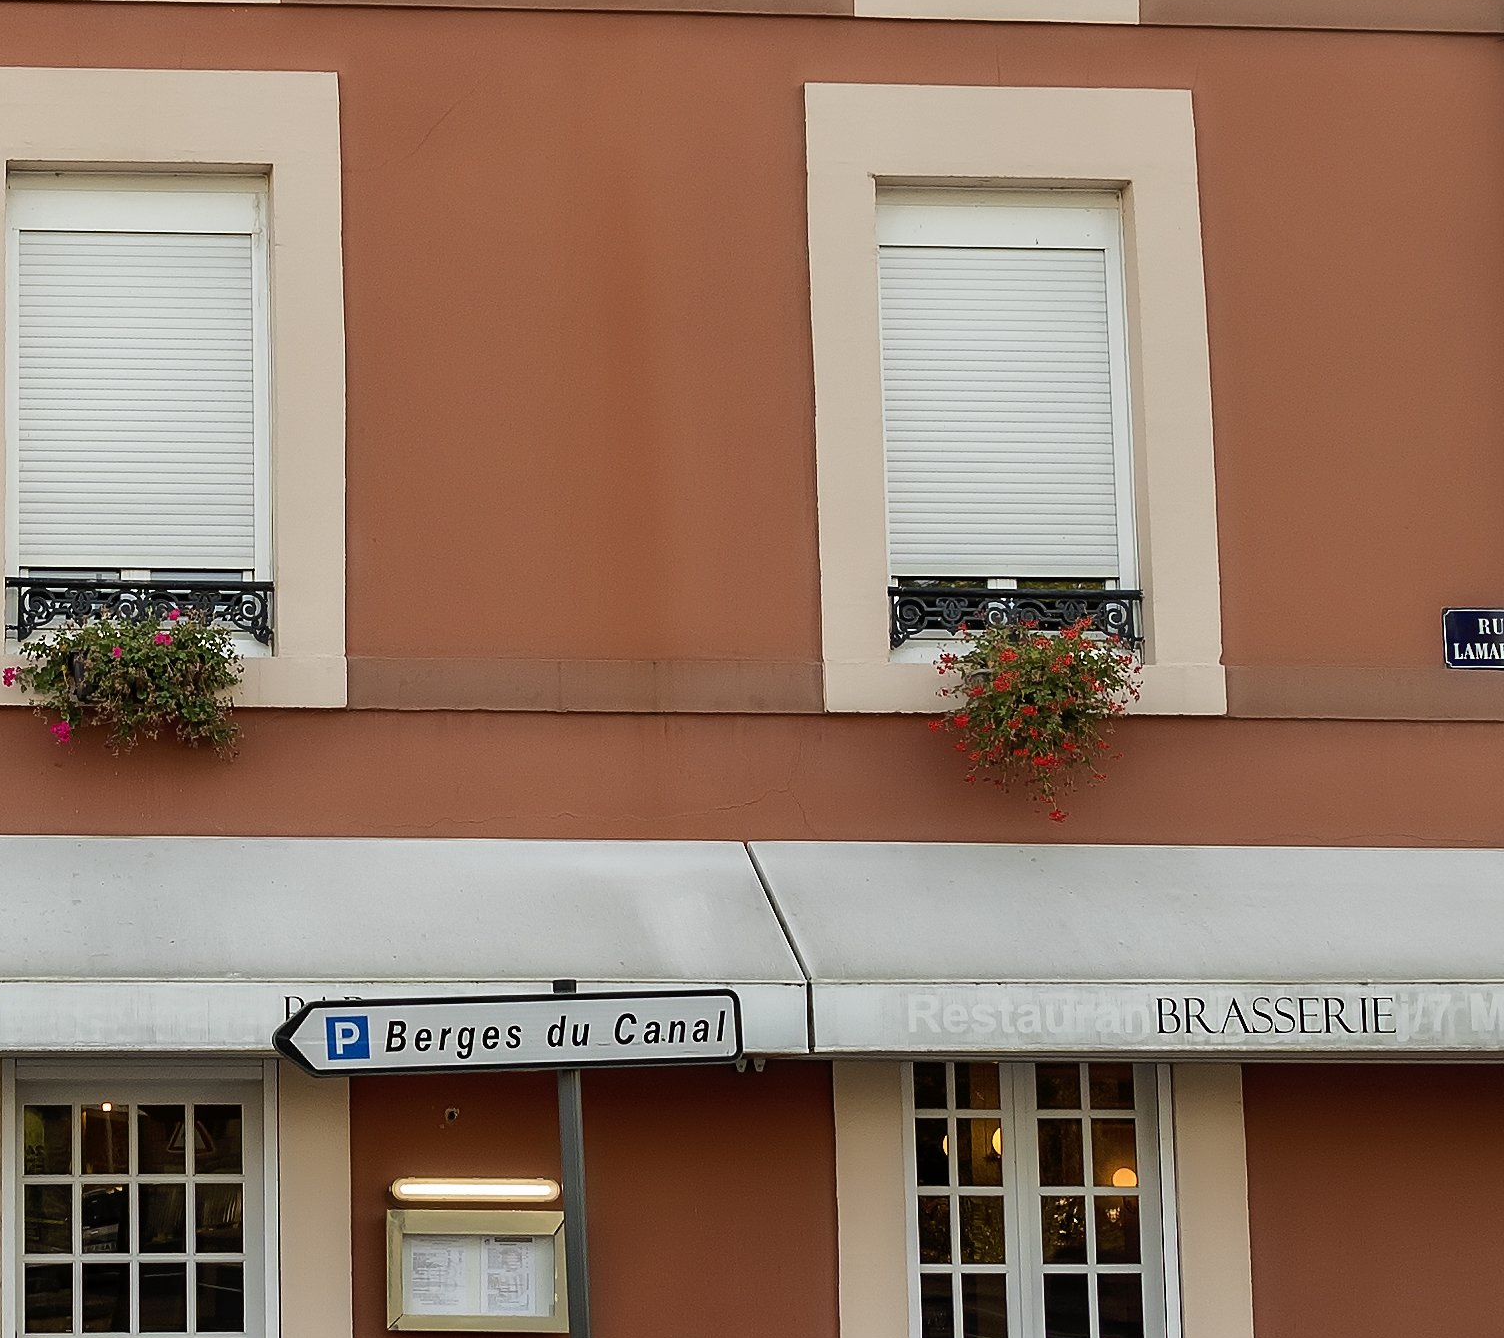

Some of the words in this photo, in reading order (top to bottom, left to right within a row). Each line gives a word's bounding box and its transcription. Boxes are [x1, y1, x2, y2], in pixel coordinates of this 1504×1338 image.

[385, 1020, 523, 1059] Berges
[547, 1015, 590, 1047] du
[614, 1010, 727, 1046] Canal
[907, 992, 1160, 1035] Restauran
[1156, 996, 1398, 1035] BRASSERIE
